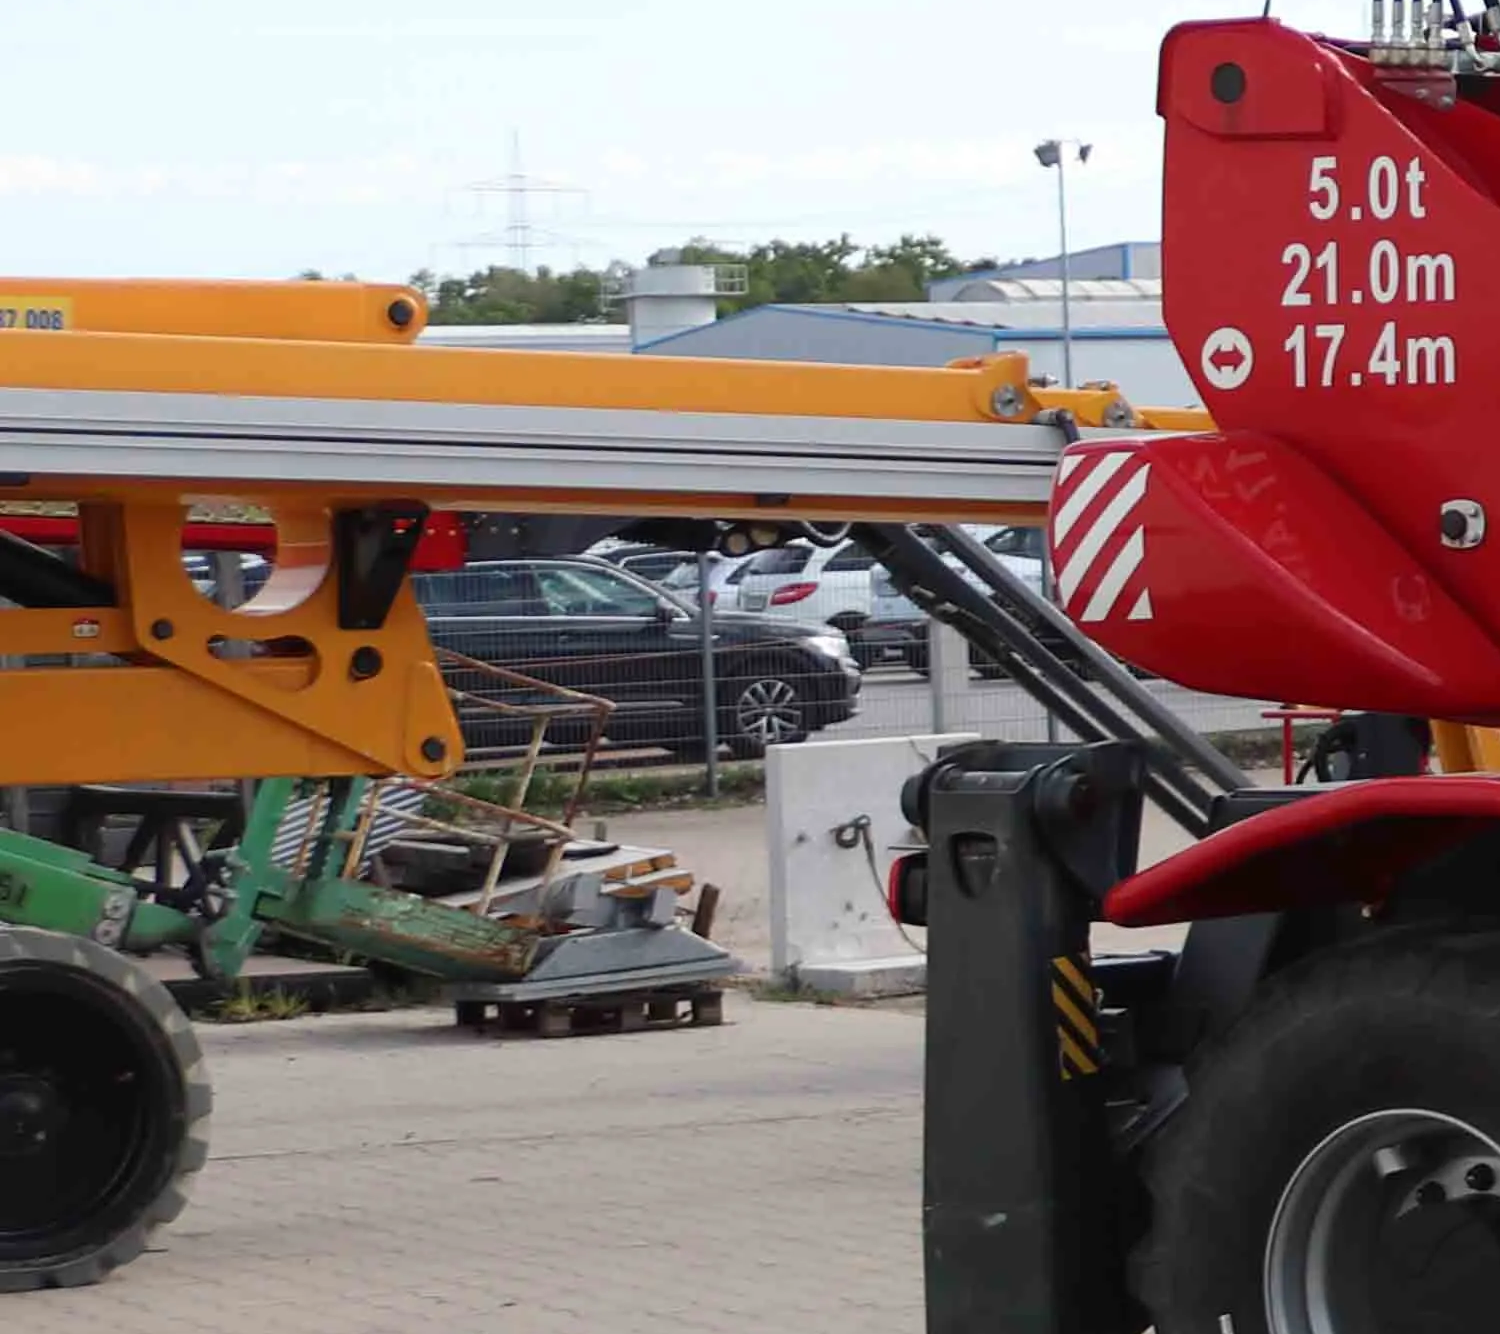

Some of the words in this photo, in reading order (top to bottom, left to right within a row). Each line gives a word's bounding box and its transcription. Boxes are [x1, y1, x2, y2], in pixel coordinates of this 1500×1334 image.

[1309, 155, 1426, 221] 5.0t
[1280, 240, 1455, 307] 21.0m
[1284, 321, 1455, 388] 17.4m
